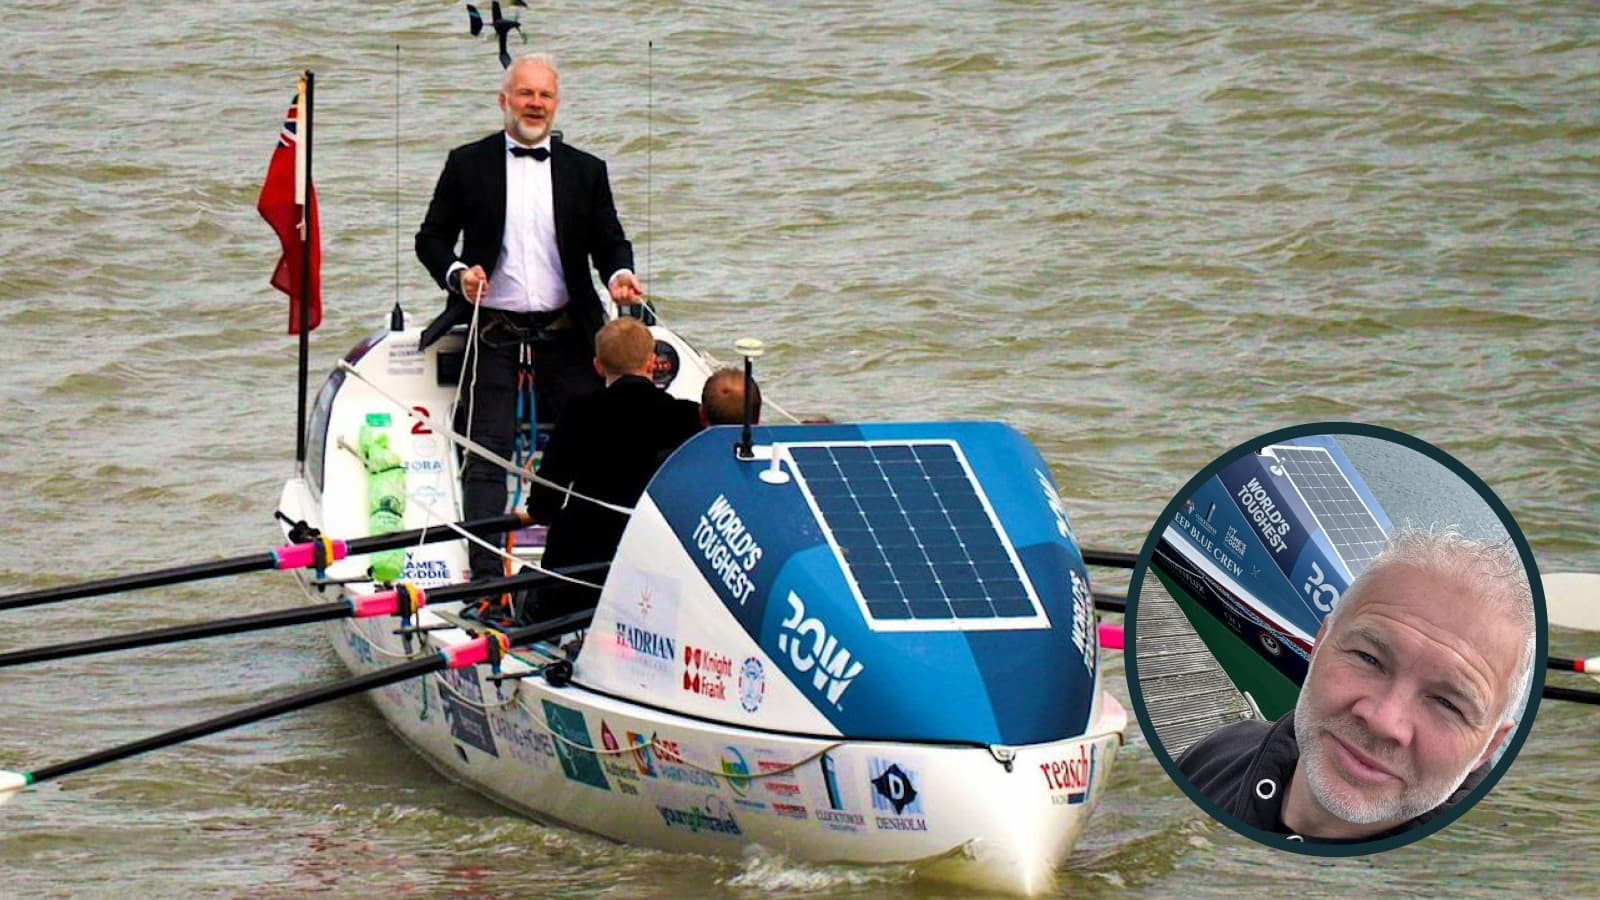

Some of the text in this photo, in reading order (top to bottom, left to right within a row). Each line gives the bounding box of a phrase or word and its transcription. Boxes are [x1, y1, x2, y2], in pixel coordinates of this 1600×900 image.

[707, 494, 763, 571] WORLD'S
[1237, 485, 1288, 554] TOUGHEST
[1247, 477, 1291, 536] WORLD'S
[405, 560, 448, 571] AME'S
[692, 516, 757, 606] TOUGHEST
[1174, 511, 1191, 530] EEP
[1190, 526, 1214, 552] BLUE
[1213, 548, 1244, 577] CREW
[1303, 560, 1341, 613] RO
[615, 621, 677, 662] HADRIAN
[703, 651, 733, 678] Knight
[778, 589, 864, 705] ROW
[701, 675, 726, 700] Frank
[888, 773, 905, 800] D
[875, 815, 929, 832] DENHOLM
